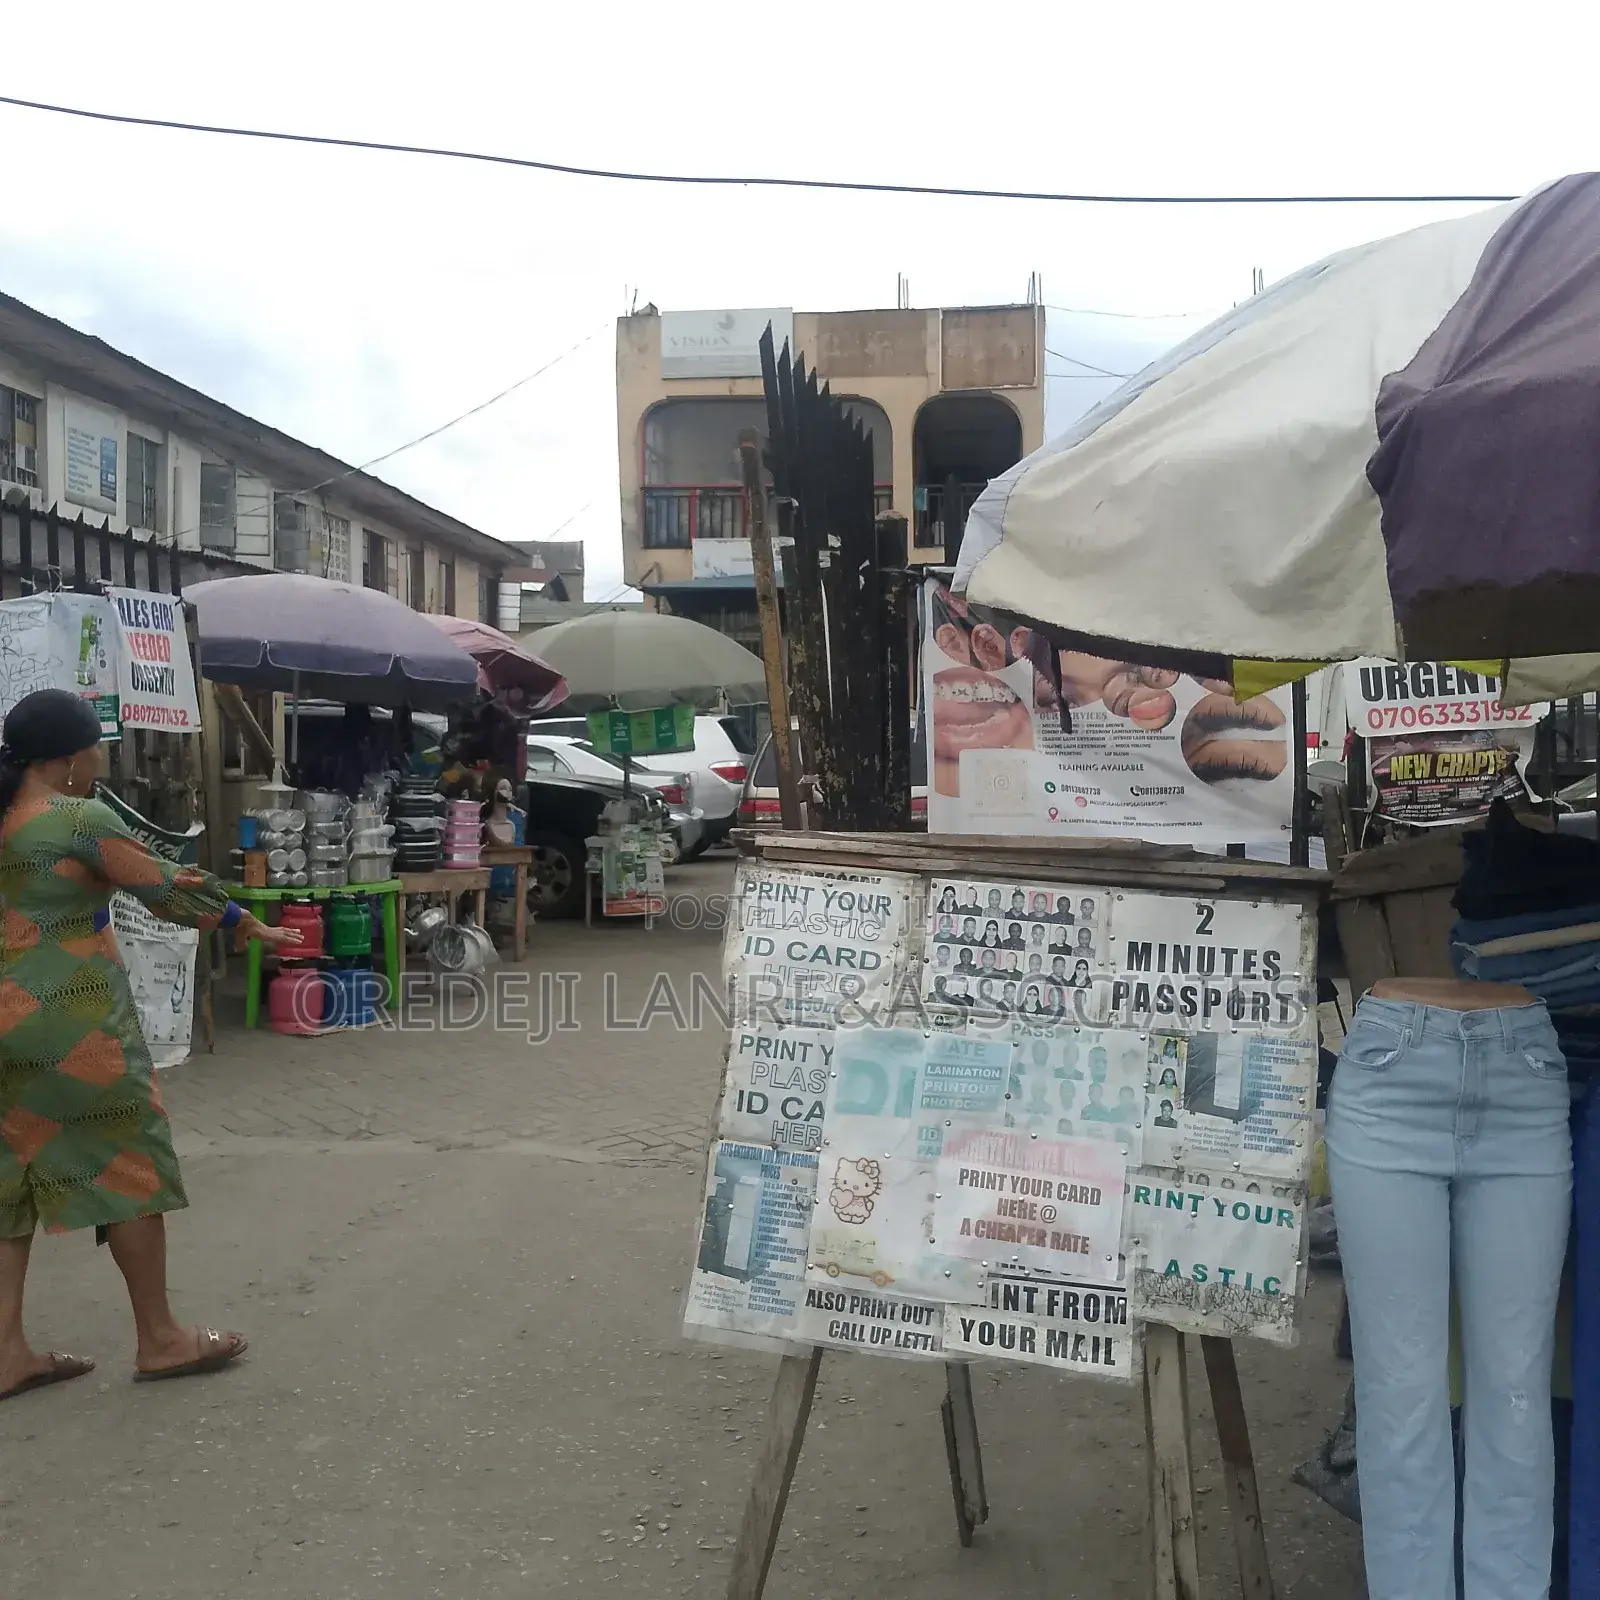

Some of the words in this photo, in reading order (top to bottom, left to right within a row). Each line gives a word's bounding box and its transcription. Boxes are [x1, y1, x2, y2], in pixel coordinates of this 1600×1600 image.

[1058, 763, 1099, 771] TRAINING
[1101, 763, 1144, 772] AVAILABLE
[1390, 753, 1433, 781] NEW
[743, 880, 815, 906] PRINT
[822, 888, 892, 917] YOUR
[746, 906, 882, 942] PLASTIC
[1195, 904, 1215, 936] 2
[744, 935, 775, 957] ID
[786, 941, 882, 971] CARD
[1126, 941, 1281, 982] MINUTES
[763, 963, 857, 995] HERE
[1112, 981, 1294, 1024] PASSPORT
[739, 1034, 814, 1063] PRINT
[750, 1061, 827, 1094] PLAS
[923, 1081, 999, 1094] PRINTOUT
[926, 1065, 1001, 1078] LAMINATION
[737, 1090, 769, 1115] ID
[1244, 1125, 1279, 1136] PHOTOCOPY
[958, 1167, 1008, 1192] PRINT
[1010, 1175, 1053, 1199] YOUR
[1056, 1182, 1102, 1206] CARD
[997, 1197, 1038, 1221] HERE
[1040, 1204, 1058, 1224] @
[1213, 1197, 1294, 1229] YOUR
[959, 1217, 971, 1236] A
[974, 1219, 1048, 1249] CHEAPER
[1049, 1231, 1090, 1255] RATE
[805, 1287, 845, 1313] ALSO
[849, 1295, 899, 1321] PRINT
[900, 1302, 935, 1326] OUT
[1046, 1289, 1128, 1326] FROM
[828, 1319, 869, 1343] CALL
[870, 1325, 892, 1346] UP
[959, 1316, 1036, 1355] YOUR
[1045, 1330, 1116, 1366] MAIL
